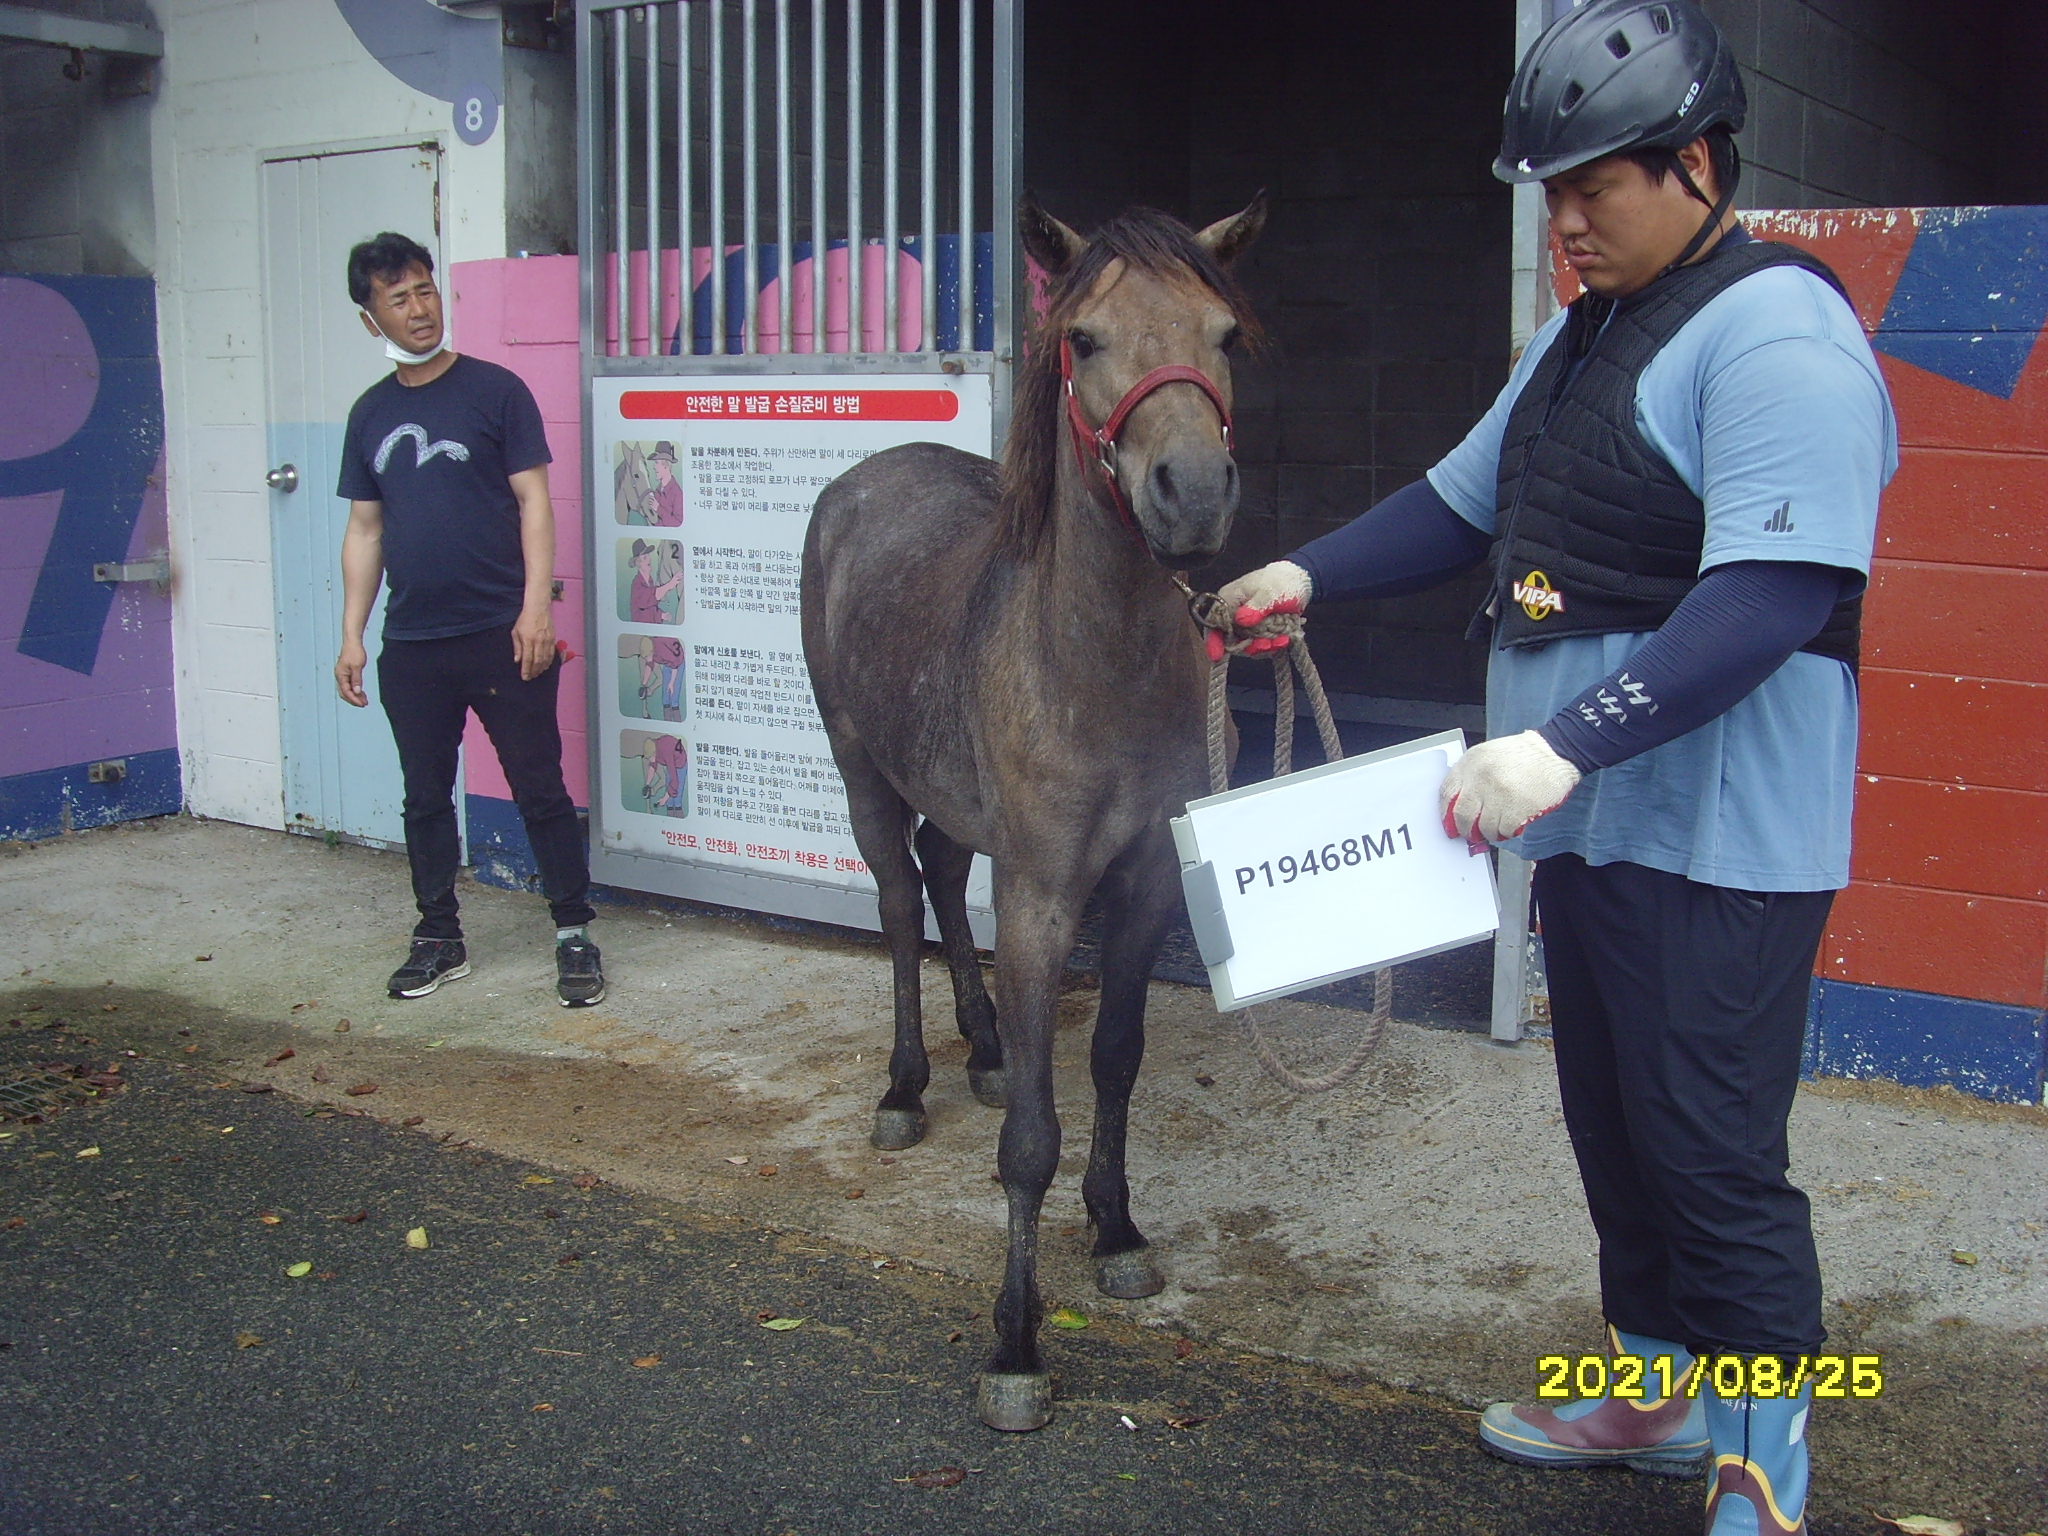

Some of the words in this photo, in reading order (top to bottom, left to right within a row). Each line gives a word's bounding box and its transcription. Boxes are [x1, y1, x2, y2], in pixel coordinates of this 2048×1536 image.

[1677, 82, 1700, 118] KED
[465, 97, 483, 131] 8
[686, 396, 723, 413] 안전한
[728, 396, 740, 413] 말
[745, 396, 770, 413] 발굽
[775, 396, 827, 413] 손질준비
[833, 396, 860, 413] 방법
[690, 446, 704, 457] 말을
[706, 446, 734, 457] 차분하게
[736, 447, 760, 458] 만든다.
[762, 447, 785, 458] 주위가
[818, 448, 834, 459] 말이
[836, 449, 844, 459] 세
[690, 459, 711, 470] 조용한
[713, 460, 741, 470] 장소에서
[744, 461, 774, 471] 작업한다.
[698, 473, 712, 483] 말을
[714, 473, 735, 483] 로프로
[737, 474, 766, 484] 고정하되
[767, 475, 790, 485] 로프가
[792, 475, 807, 486] 너무
[698, 486, 713, 496] 목을
[731, 487, 739, 497] 수
[698, 499, 713, 510] 너무
[715, 500, 729, 510] 길면
[731, 501, 745, 511] 말이
[747, 501, 769, 512] 머리를
[771, 502, 800, 512] 지면으로
[802, 503, 814, 514] 낮
[671, 543, 680, 559] 2
[692, 546, 713, 557] 옆에서
[714, 547, 745, 558] 시작한다.
[747, 548, 762, 559] 말이
[764, 550, 793, 561] 다가오는
[692, 559, 706, 569] 말을
[708, 560, 723, 570] 하고
[724, 560, 739, 571] 목과
[700, 572, 714, 583] 항상
[732, 574, 760, 585] 순서대로
[762, 576, 791, 587] 반복하여
[723, 587, 737, 598] 발을
[739, 588, 754, 598] 안쪽
[755, 589, 763, 600] 발
[765, 590, 780, 600] 약간
[1513, 578, 1566, 612] VIPA
[736, 601, 765, 613] 시작하면
[767, 603, 782, 614] 말의
[784, 605, 799, 615] 기분
[693, 644, 715, 656] 말에게
[716, 646, 737, 658] 신호를
[739, 649, 763, 660] 보낸다.
[768, 651, 776, 661] 말
[778, 651, 792, 662] 옆에
[710, 659, 731, 670] 내려간
[742, 662, 763, 673] 가볍게
[765, 664, 797, 676] 두드린다.
[733, 674, 754, 685] 다리를
[756, 676, 771, 686] 바로
[782, 679, 807, 691] 것이다.
[710, 685, 725, 696] 않기
[726, 687, 748, 698] 때문에
[749, 689, 771, 700] 작업전
[773, 691, 795, 703] 반드시
[797, 693, 813, 704] 이를
[694, 697, 715, 708] 다리를
[717, 698, 734, 710] 든다.
[736, 700, 750, 711] 말이
[752, 702, 774, 714] 자세를
[776, 705, 791, 715] 바로
[704, 710, 725, 721] 지시에
[743, 715, 764, 726] 따르지
[766, 717, 788, 729] 않으면
[695, 742, 710, 753] 발을
[743, 748, 758, 759] 발을
[760, 749, 795, 763] 들어올리면
[696, 767, 711, 779] 잡아
[734, 772, 756, 784] 쪽으로
[736, 760, 751, 770] 잡고
[753, 762, 768, 773] 있는
[769, 764, 791, 776] 손에서
[793, 767, 808, 778] 발을
[695, 781, 723, 793] 움직임을
[758, 788, 765, 799] 수
[696, 793, 711, 804] 말이
[735, 799, 756, 810] 멈추고
[758, 802, 779, 814] 긴장을
[798, 807, 820, 819] 다리를
[823, 810, 838, 821] 잡고
[840, 813, 851, 824] 있
[697, 806, 711, 817] 말이
[712, 808, 720, 818] 세
[722, 810, 743, 821] 다리로
[768, 816, 775, 826] 선
[777, 818, 799, 830] 이후에
[825, 824, 841, 836] 파되
[843, 826, 854, 837] 다
[705, 837, 741, 857] 안전화,
[746, 843, 790, 864] 안전조끼
[794, 850, 829, 870] 착용은
[1235, 823, 1414, 895] P19468M1
